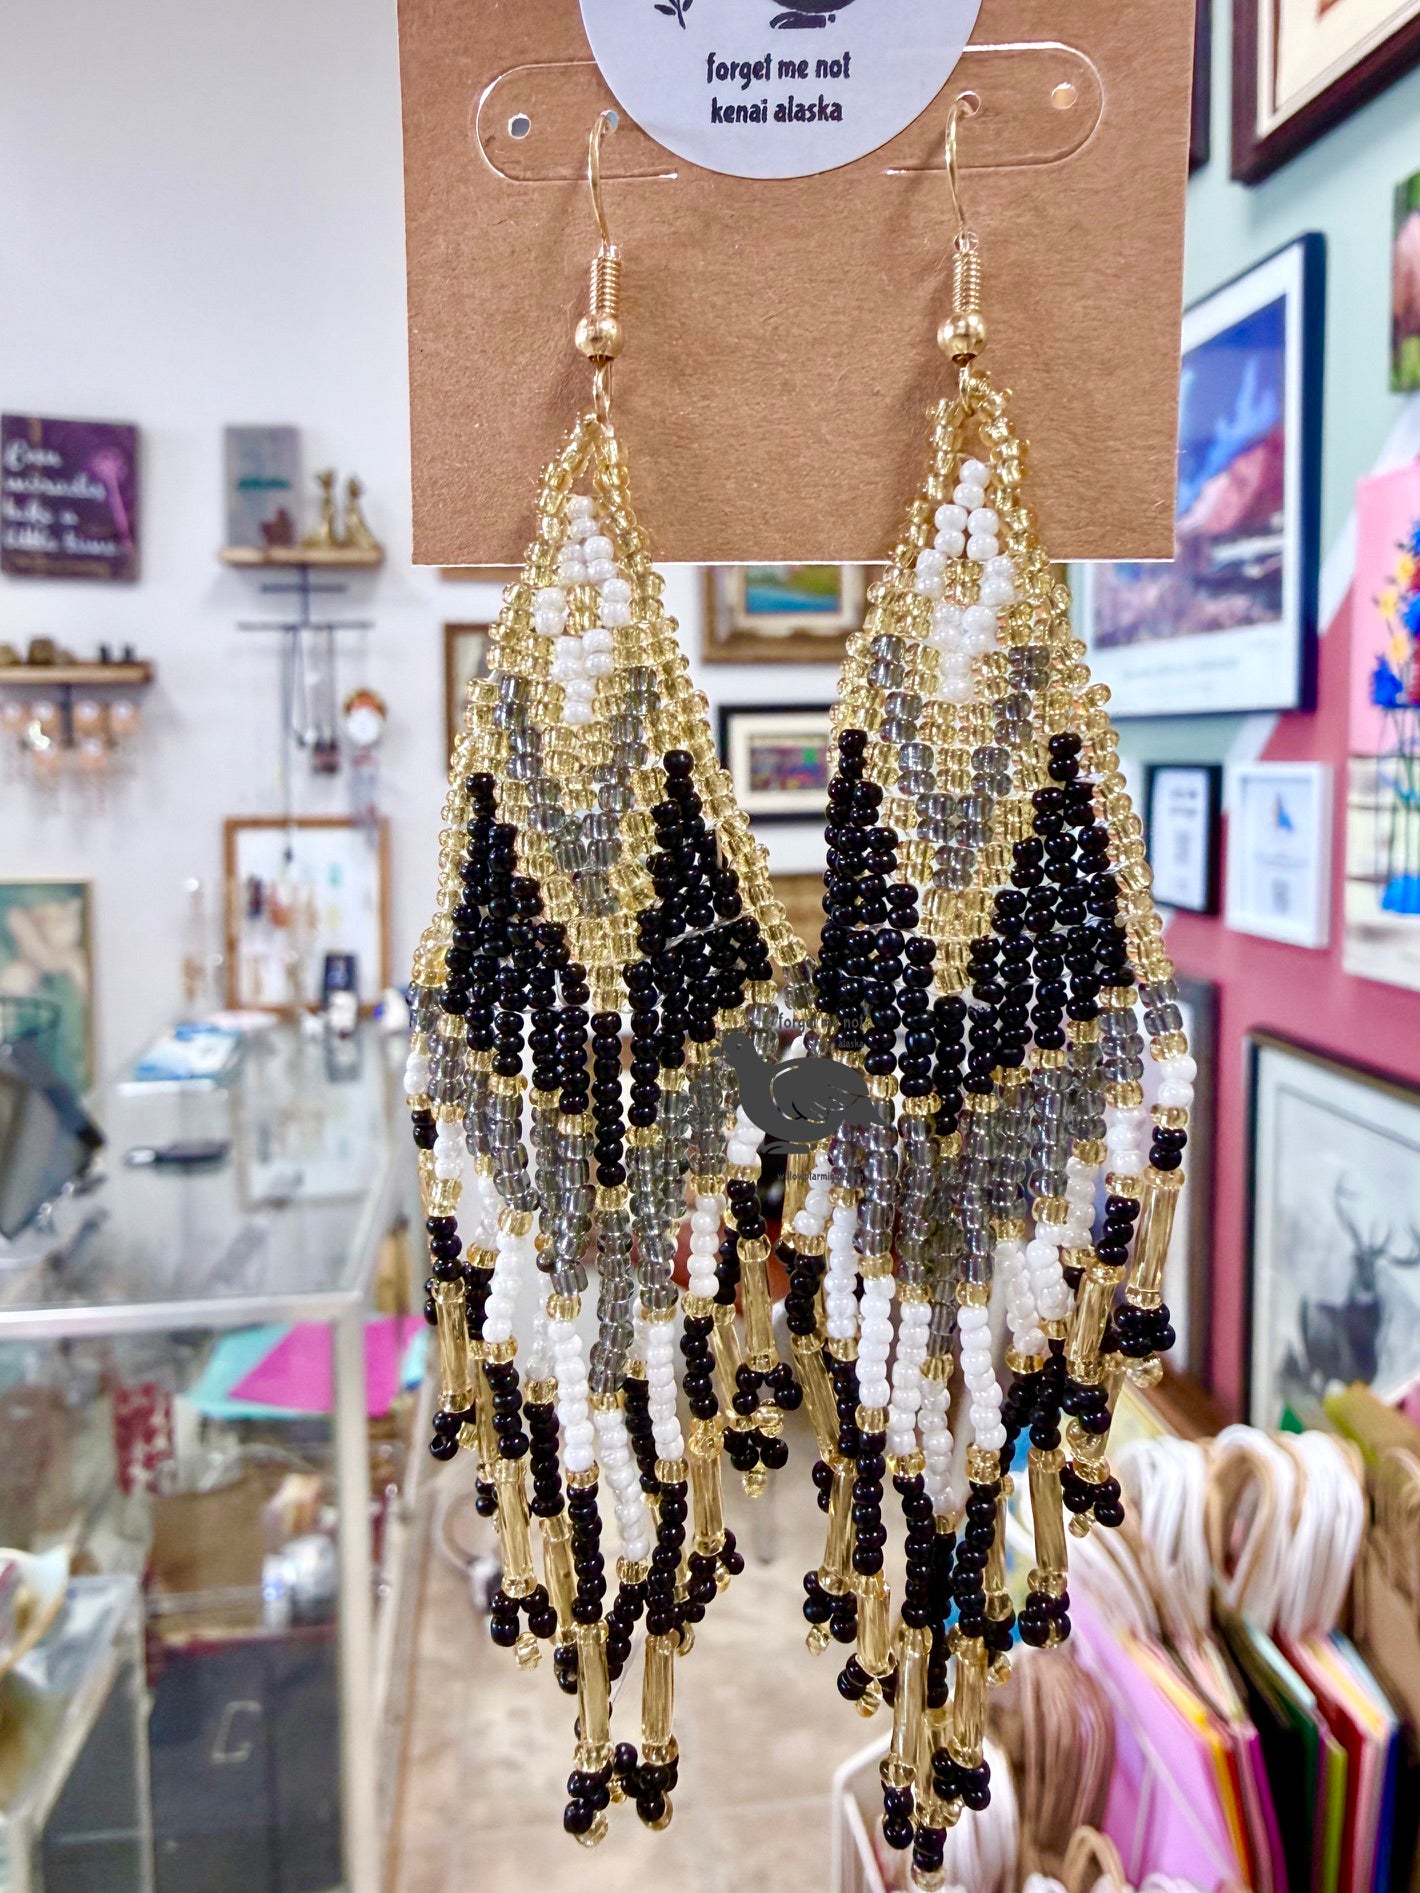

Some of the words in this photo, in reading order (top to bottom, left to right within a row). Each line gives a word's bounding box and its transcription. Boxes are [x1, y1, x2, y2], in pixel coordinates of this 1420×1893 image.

[706, 52, 772, 91] forget
[778, 59, 809, 80] me
[815, 51, 851, 79] not
[711, 96, 768, 123] kenai
[773, 94, 843, 123] alaska
